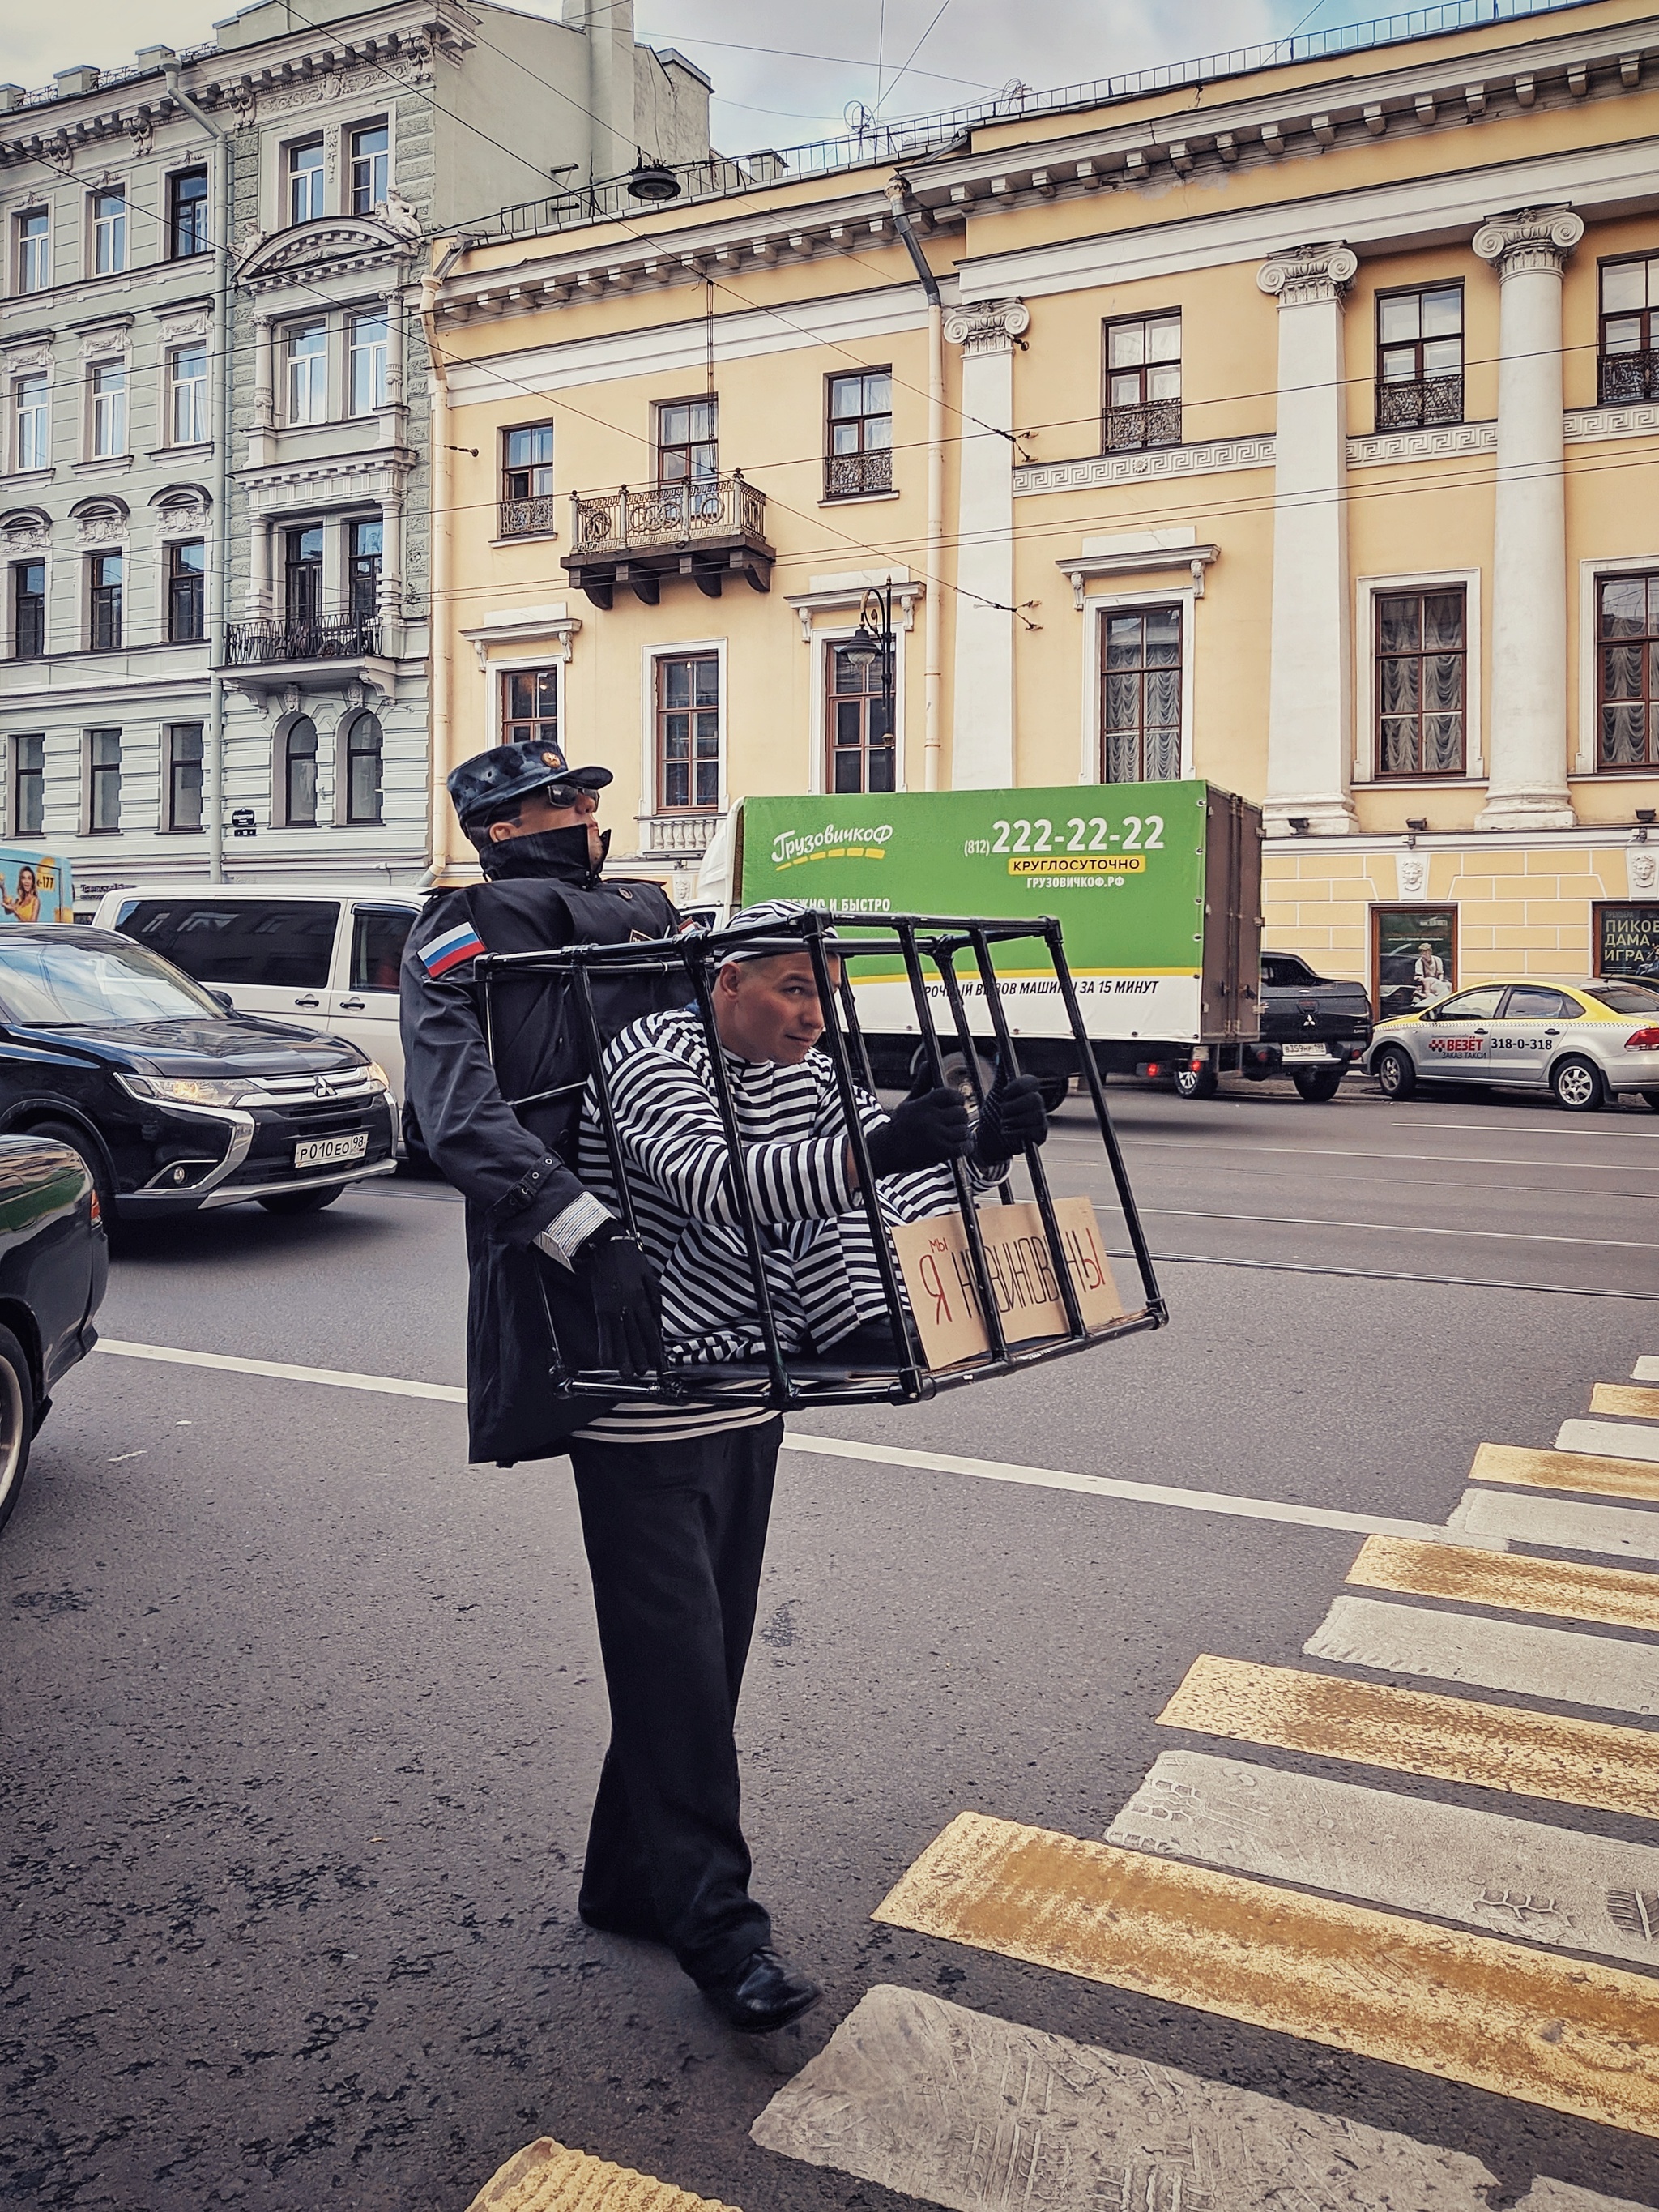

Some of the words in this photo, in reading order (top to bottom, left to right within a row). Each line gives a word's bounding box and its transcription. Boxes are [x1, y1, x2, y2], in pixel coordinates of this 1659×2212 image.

[964, 839, 990, 857] (812)
[992, 815, 1165, 853] 222-22-22
[1013, 858, 1141, 872] КРУГЛОСУТОЧНО
[1026, 875, 1125, 890] ГРУЗОВИЧКОФ.РФ
[829, 898, 838, 912] И
[841, 897, 891, 912] БЫСТРО
[1604, 949, 1645, 962] ИГРА
[1079, 981, 1094, 994] ЗА
[1098, 981, 1112, 993] 15
[1114, 980, 1160, 994] МИНУТ
[1447, 1036, 1484, 1052] ВЕЗЁТ
[1491, 1038, 1553, 1050] 318-0-318
[1442, 1052, 1463, 1060] ЗАКАЗ
[1464, 1052, 1486, 1060] ТАКСИ
[919, 1254, 953, 1325] Я
